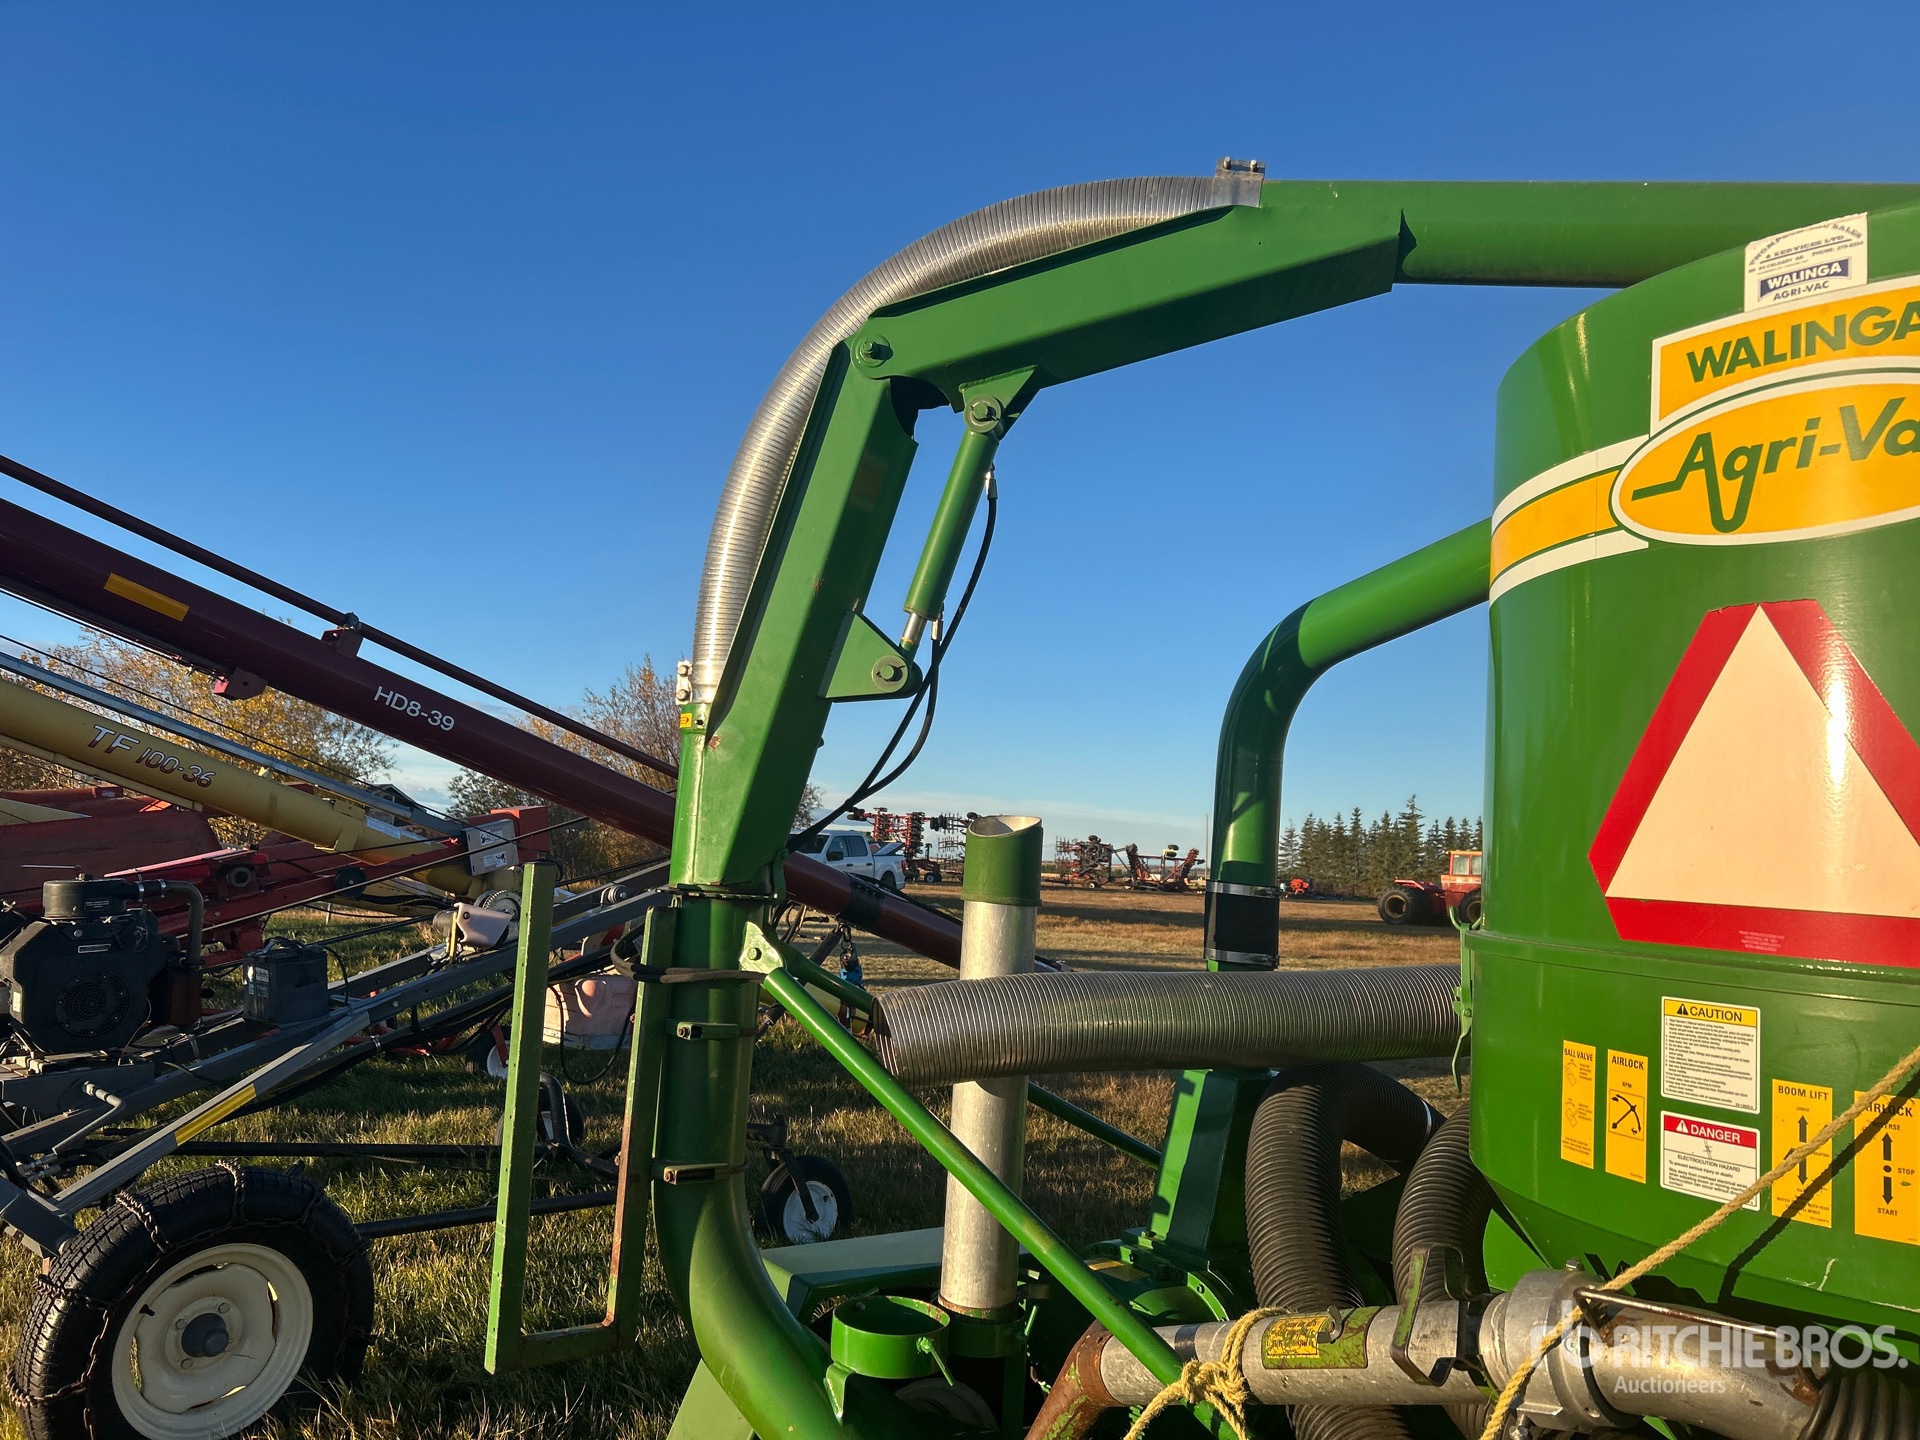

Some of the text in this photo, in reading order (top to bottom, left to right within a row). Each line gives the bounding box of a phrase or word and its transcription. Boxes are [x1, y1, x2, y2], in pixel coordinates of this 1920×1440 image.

[1767, 262, 1842, 290] WALINGA
[1773, 281, 1829, 300] AGRI-VAC
[1687, 301, 1920, 383] WALINGA
[373, 685, 455, 731] HD8-39
[87, 724, 216, 788] TF 100-36
[1690, 1006, 1742, 1022] CAUTION
[1564, 1048, 1576, 1058] BALL
[1577, 1051, 1593, 1061] VALVE
[1612, 1056, 1644, 1070] AIRLOCK
[1778, 1085, 1829, 1100] BOOM LIFT
[1864, 1103, 1913, 1117] IRLOCK
[1691, 1124, 1741, 1144] DANGER
[1678, 1154, 1740, 1173] ELECTROCUTION HAZARD
[1877, 1208, 1898, 1216] START
